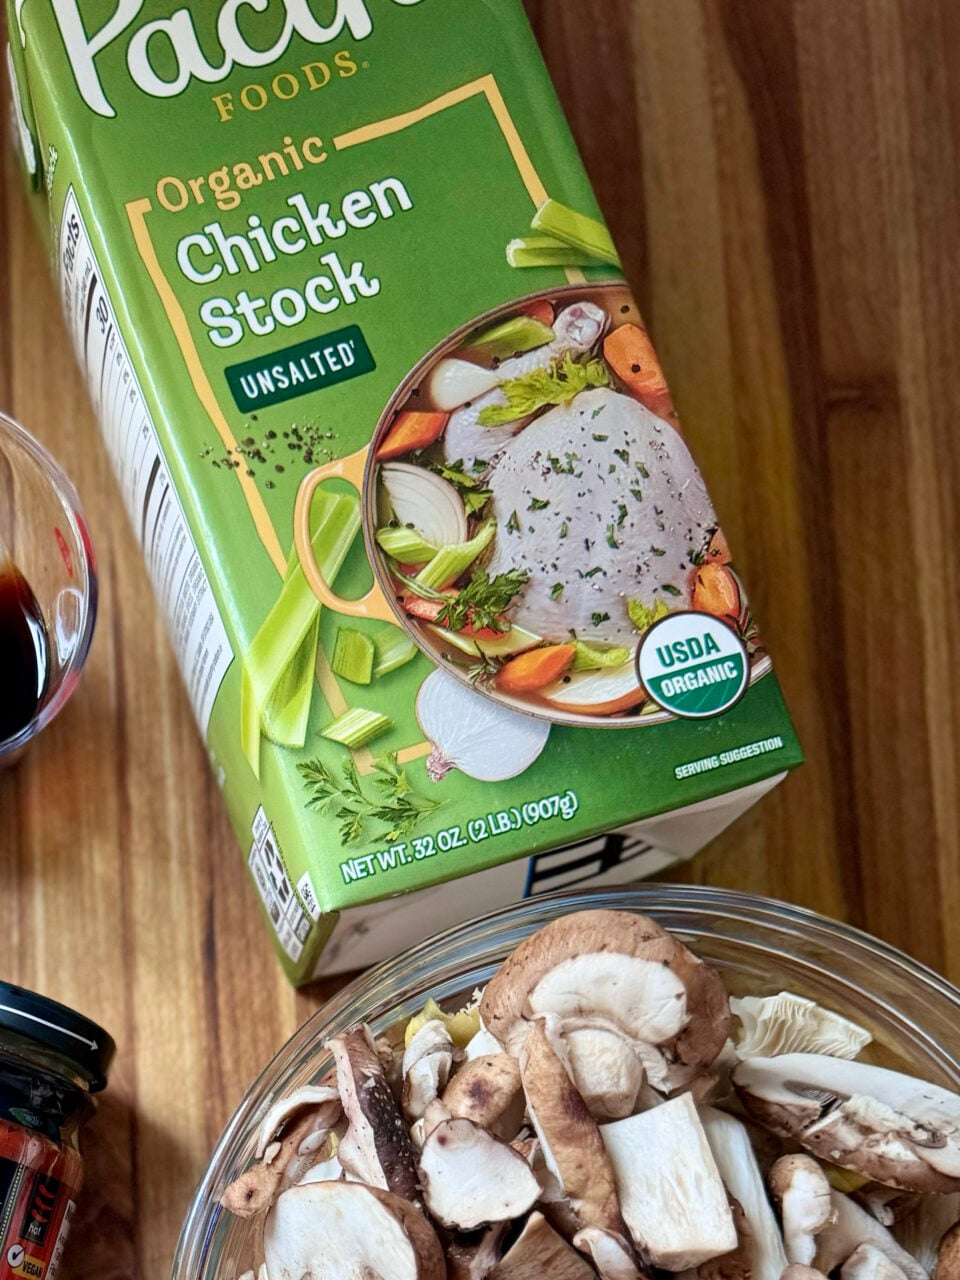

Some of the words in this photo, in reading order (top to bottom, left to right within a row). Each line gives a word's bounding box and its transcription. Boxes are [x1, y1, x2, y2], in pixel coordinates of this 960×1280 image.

[211, 50, 358, 122] FOODS
[156, 136, 327, 212] Organic
[176, 177, 414, 284] Chicken
[199, 252, 381, 348] Stock
[656, 632, 721, 668] USDA
[660, 661, 738, 698] ORGANIC
[675, 756, 719, 780] SERVING
[719, 736, 784, 765] SUGGESTION
[340, 854, 375, 883] NET
[376, 844, 412, 871] WT.
[412, 837, 436, 860] 32
[436, 827, 467, 851] OZ.
[468, 816, 488, 842] (2
[488, 809, 522, 838] LB.)
[522, 790, 578, 825] (907g)
[28, 1223, 41, 1236] hot
